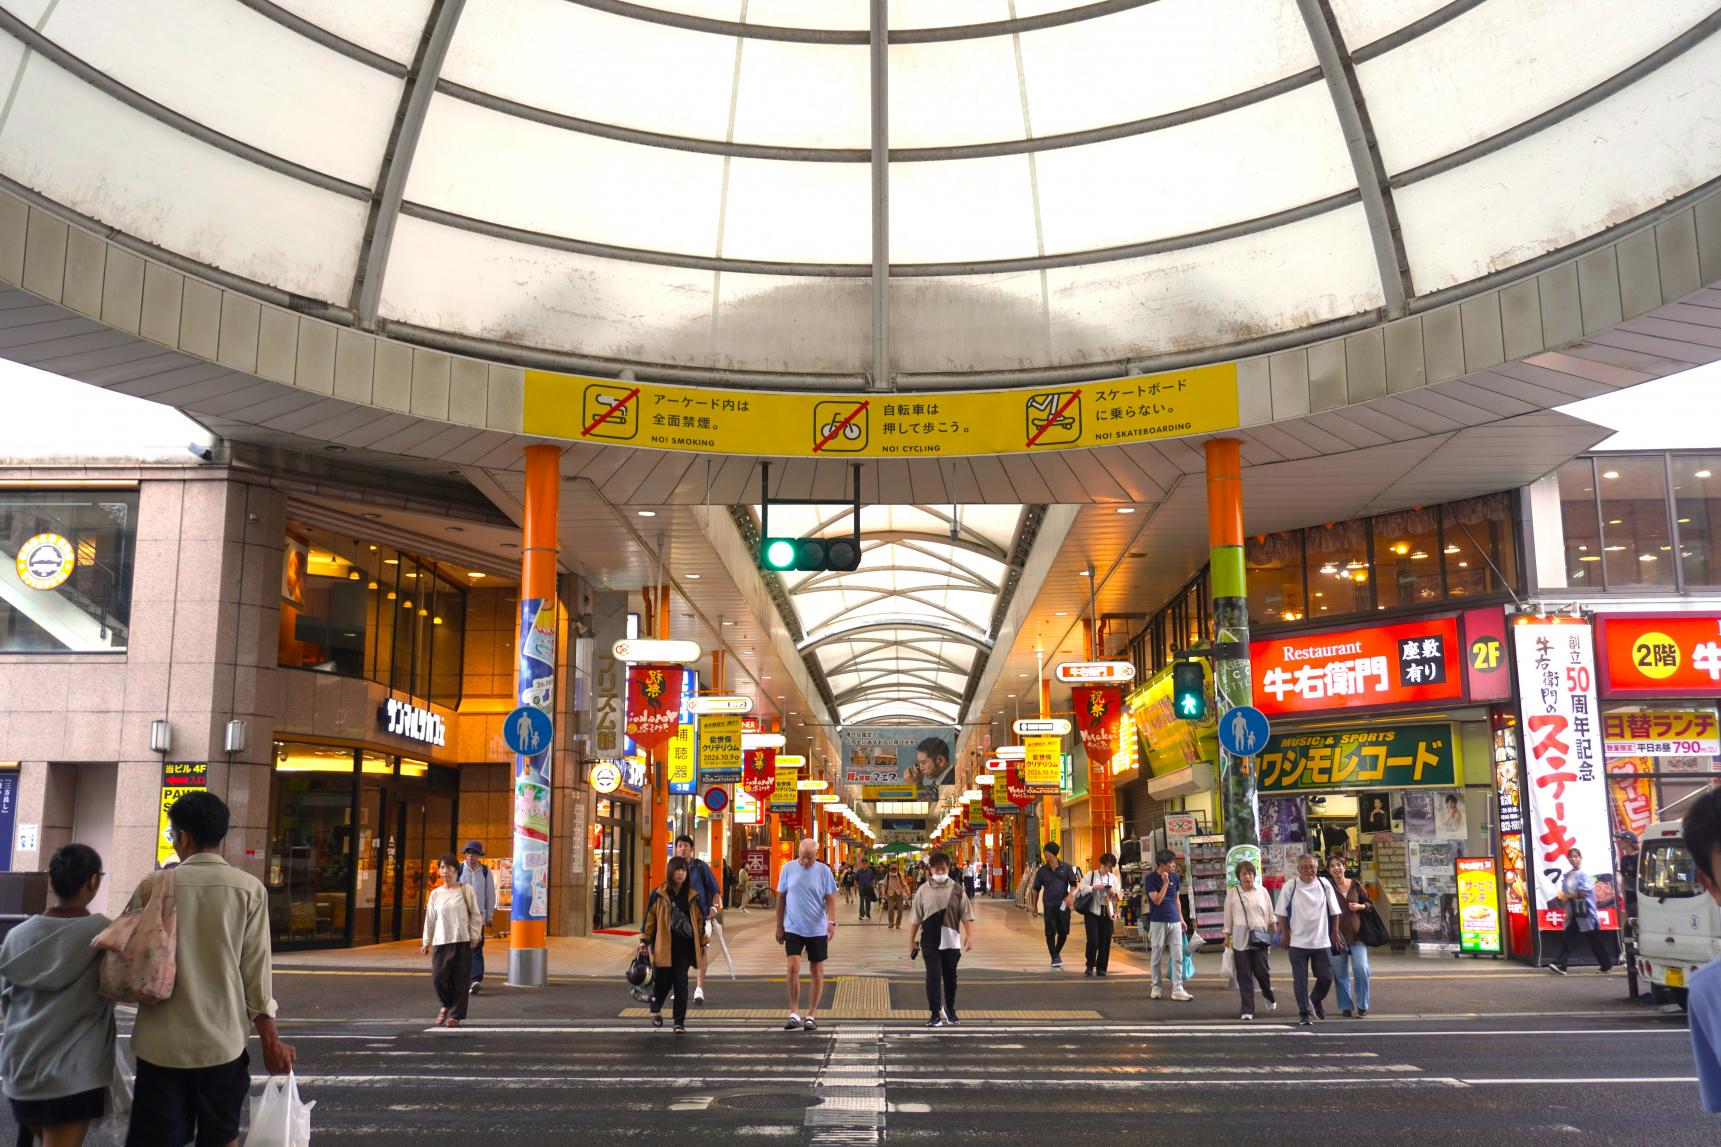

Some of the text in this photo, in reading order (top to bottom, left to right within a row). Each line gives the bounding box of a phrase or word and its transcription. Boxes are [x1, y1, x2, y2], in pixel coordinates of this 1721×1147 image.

[1095, 379, 1187, 402] スケートボード
[654, 394, 749, 412] アーケード内は
[884, 404, 939, 416] 自転車は
[1096, 403, 1174, 421] に乗らない。
[653, 413, 718, 430] 全面禁煙。
[882, 421, 970, 435] 押して歩こう。
[1116, 422, 1192, 438] SKATEBOARDING
[671, 437, 715, 447] SMOKING
[1283, 641, 1362, 661] Restaurant
[1401, 638, 1442, 660] 座敷
[1472, 641, 1501, 669] 2F
[1636, 643, 1677, 667] 2階
[1264, 656, 1389, 702] 牛右衛門
[1405, 662, 1437, 684] 有り
[1604, 713, 1714, 739] 日替ランチ
[1281, 731, 1396, 747] MUSIC & SPORTS
[1257, 740, 1442, 787] ワシモレコード
